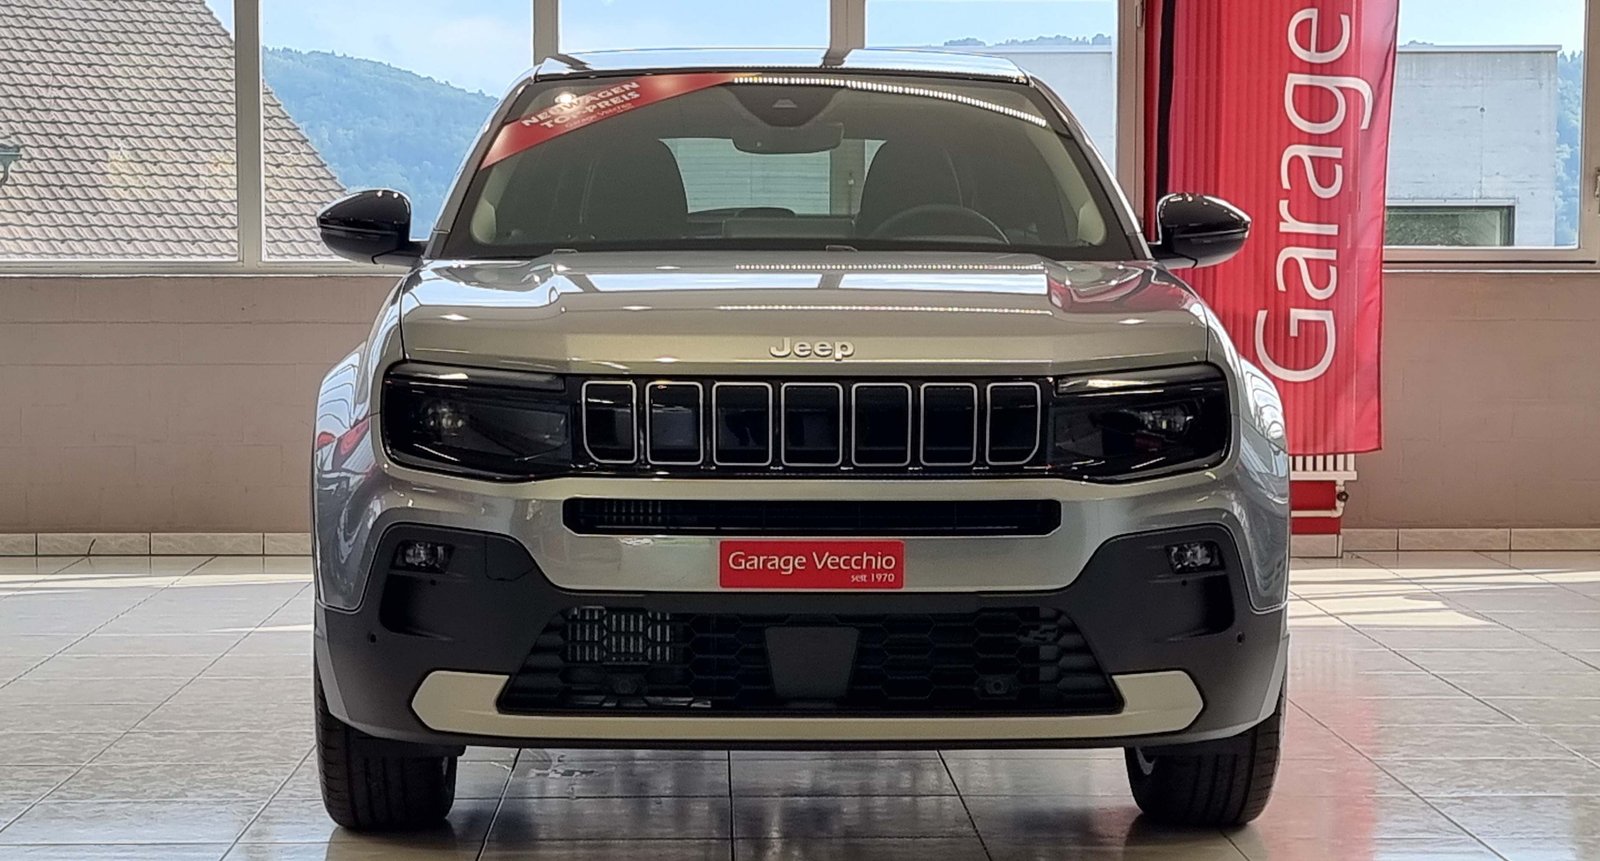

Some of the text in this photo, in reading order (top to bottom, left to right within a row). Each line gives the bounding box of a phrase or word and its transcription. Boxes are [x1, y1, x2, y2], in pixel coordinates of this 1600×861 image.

[522, 82, 639, 126] NEUWAGEN
[1254, 7, 1373, 382] Garage
[769, 336, 855, 361] Jeep
[728, 551, 896, 575] Garage Vecchio
[850, 573, 895, 583] seit 1970
